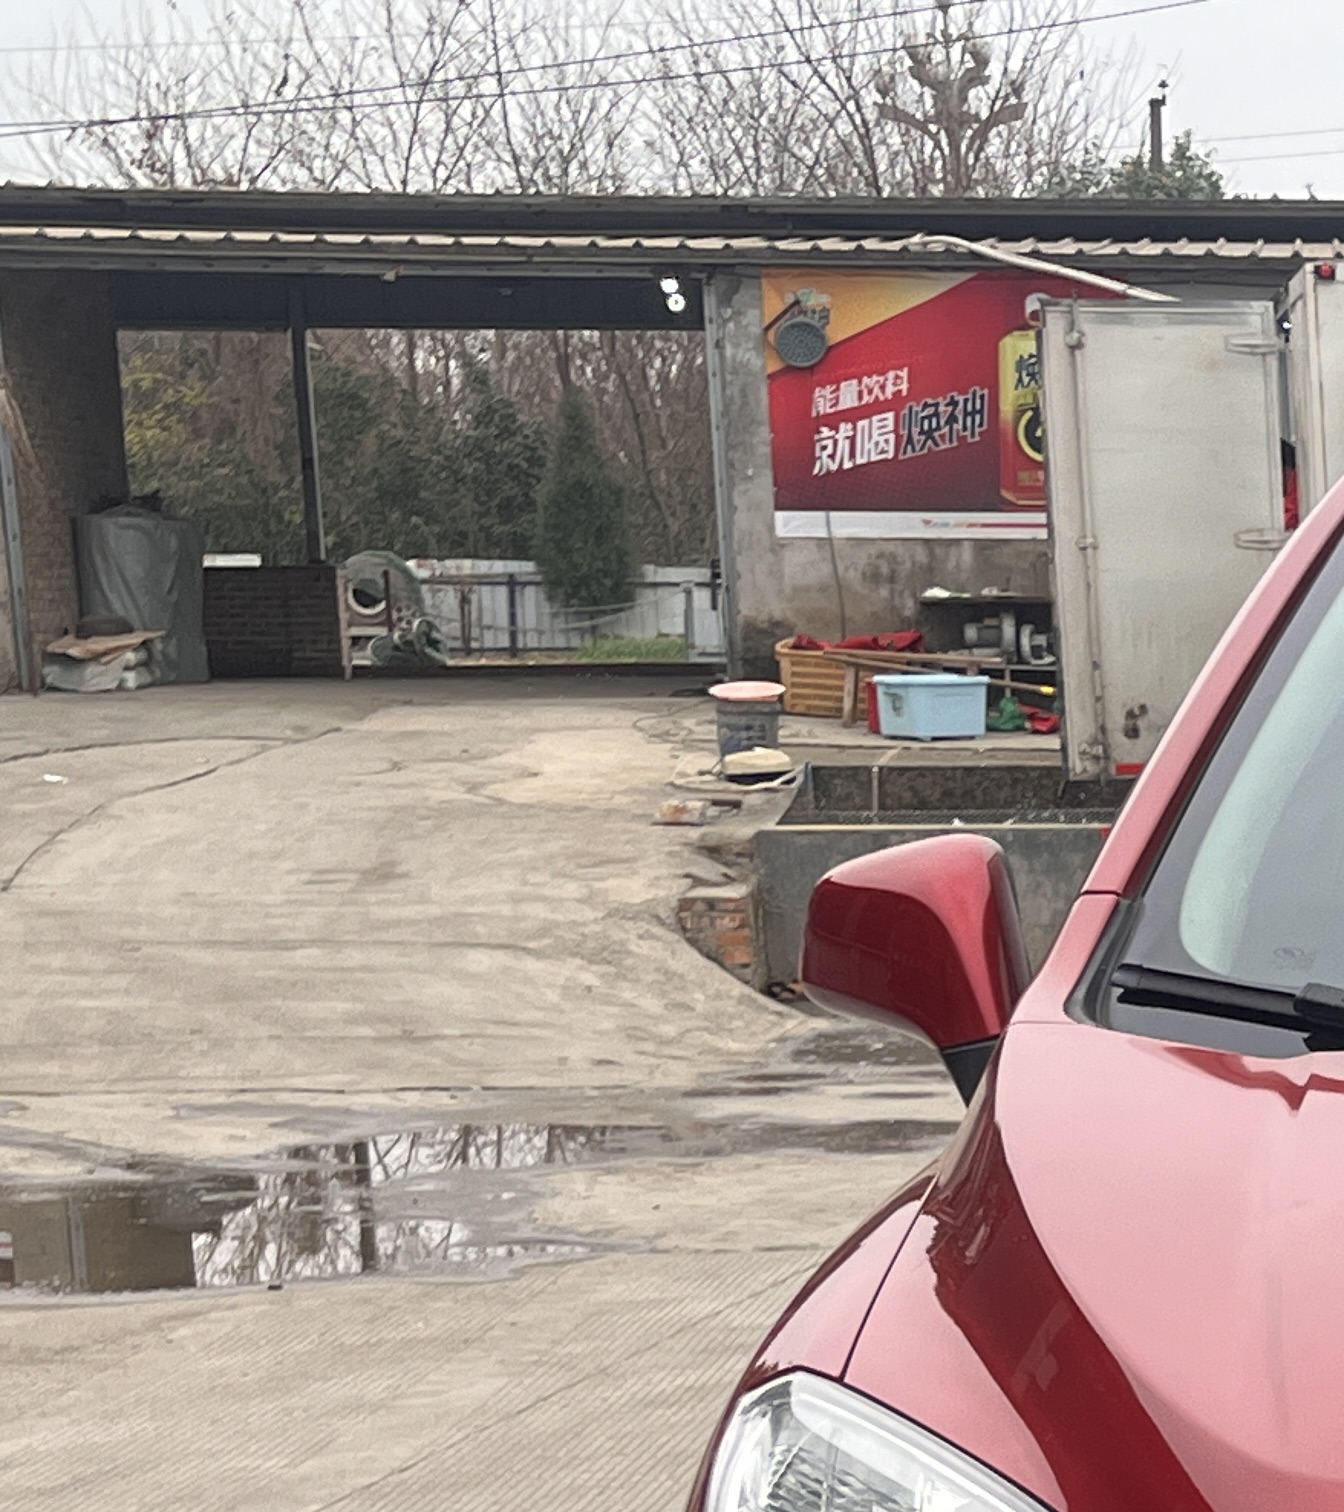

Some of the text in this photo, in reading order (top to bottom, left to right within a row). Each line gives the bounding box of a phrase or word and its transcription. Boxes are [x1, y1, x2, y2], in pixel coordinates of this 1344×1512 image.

[812, 367, 909, 418] 能量饮料
[813, 386, 988, 476] 就喝焕神
